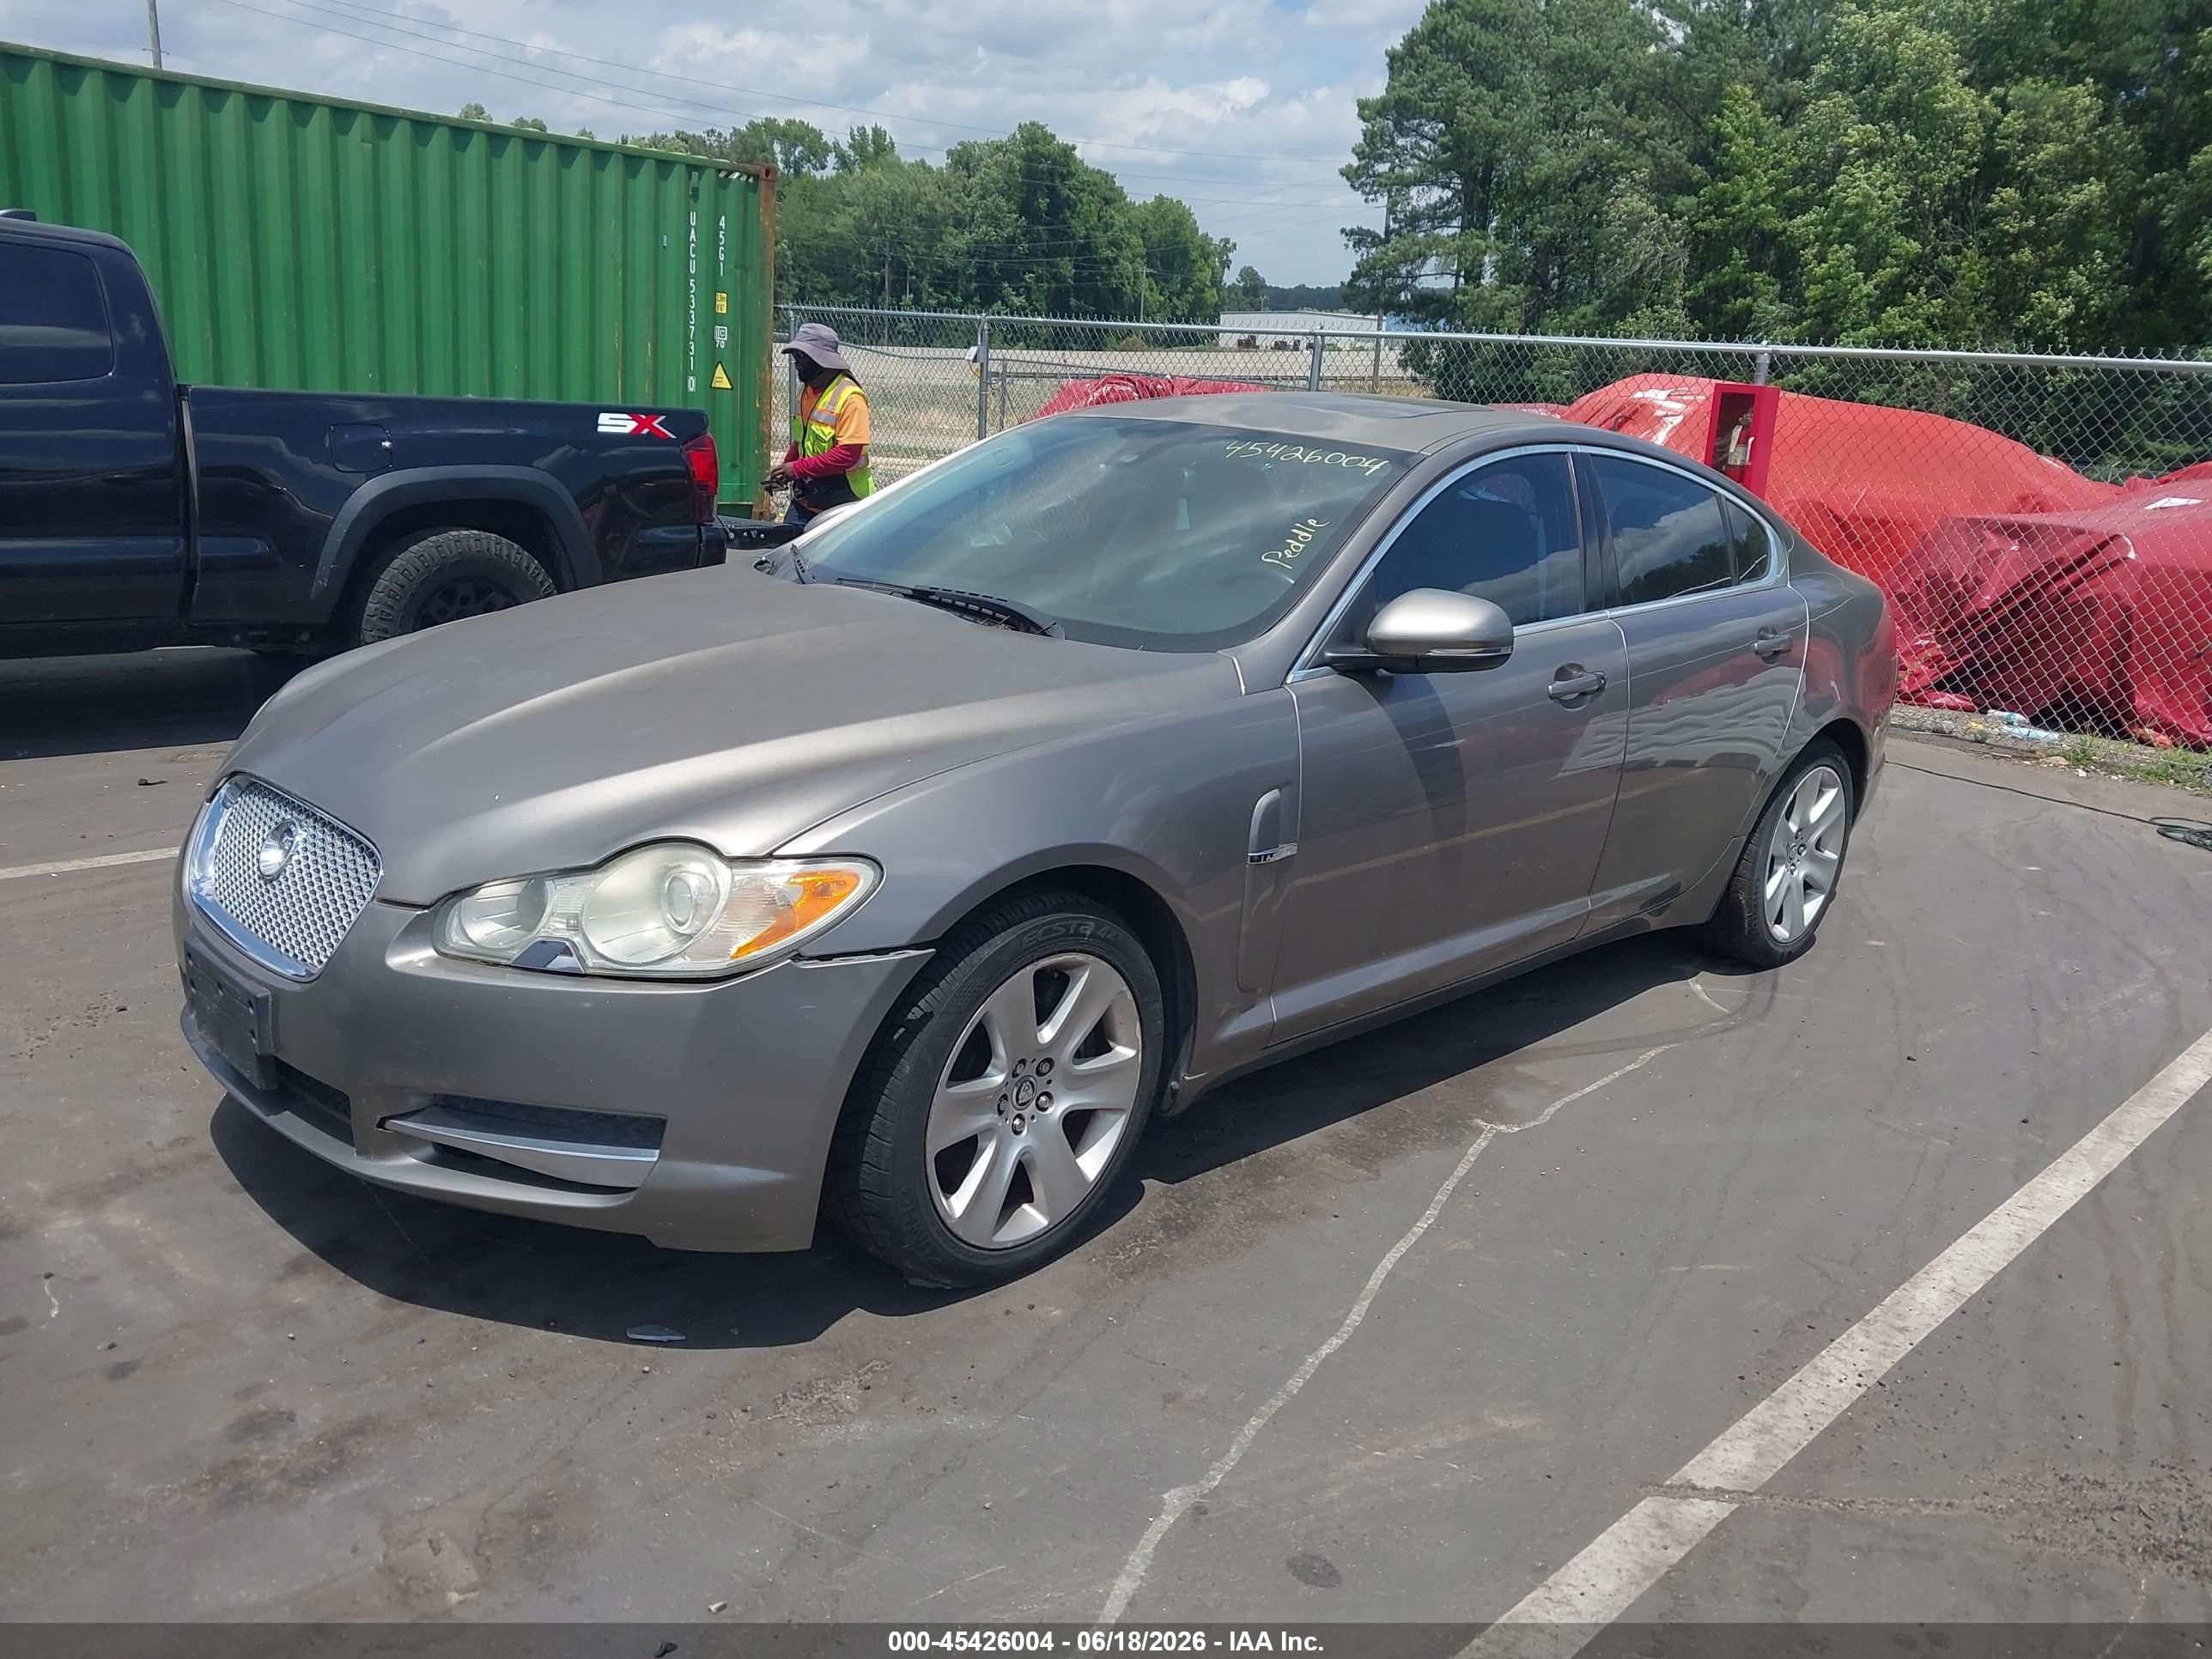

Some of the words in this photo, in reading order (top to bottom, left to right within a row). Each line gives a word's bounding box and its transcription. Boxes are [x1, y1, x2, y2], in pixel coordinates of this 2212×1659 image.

[718, 215, 726, 277] 45G1
[688, 376, 696, 392] 0
[597, 412, 678, 440] SX
[1225, 440, 1390, 476] 45426004
[1260, 518, 1331, 569] Peddle
